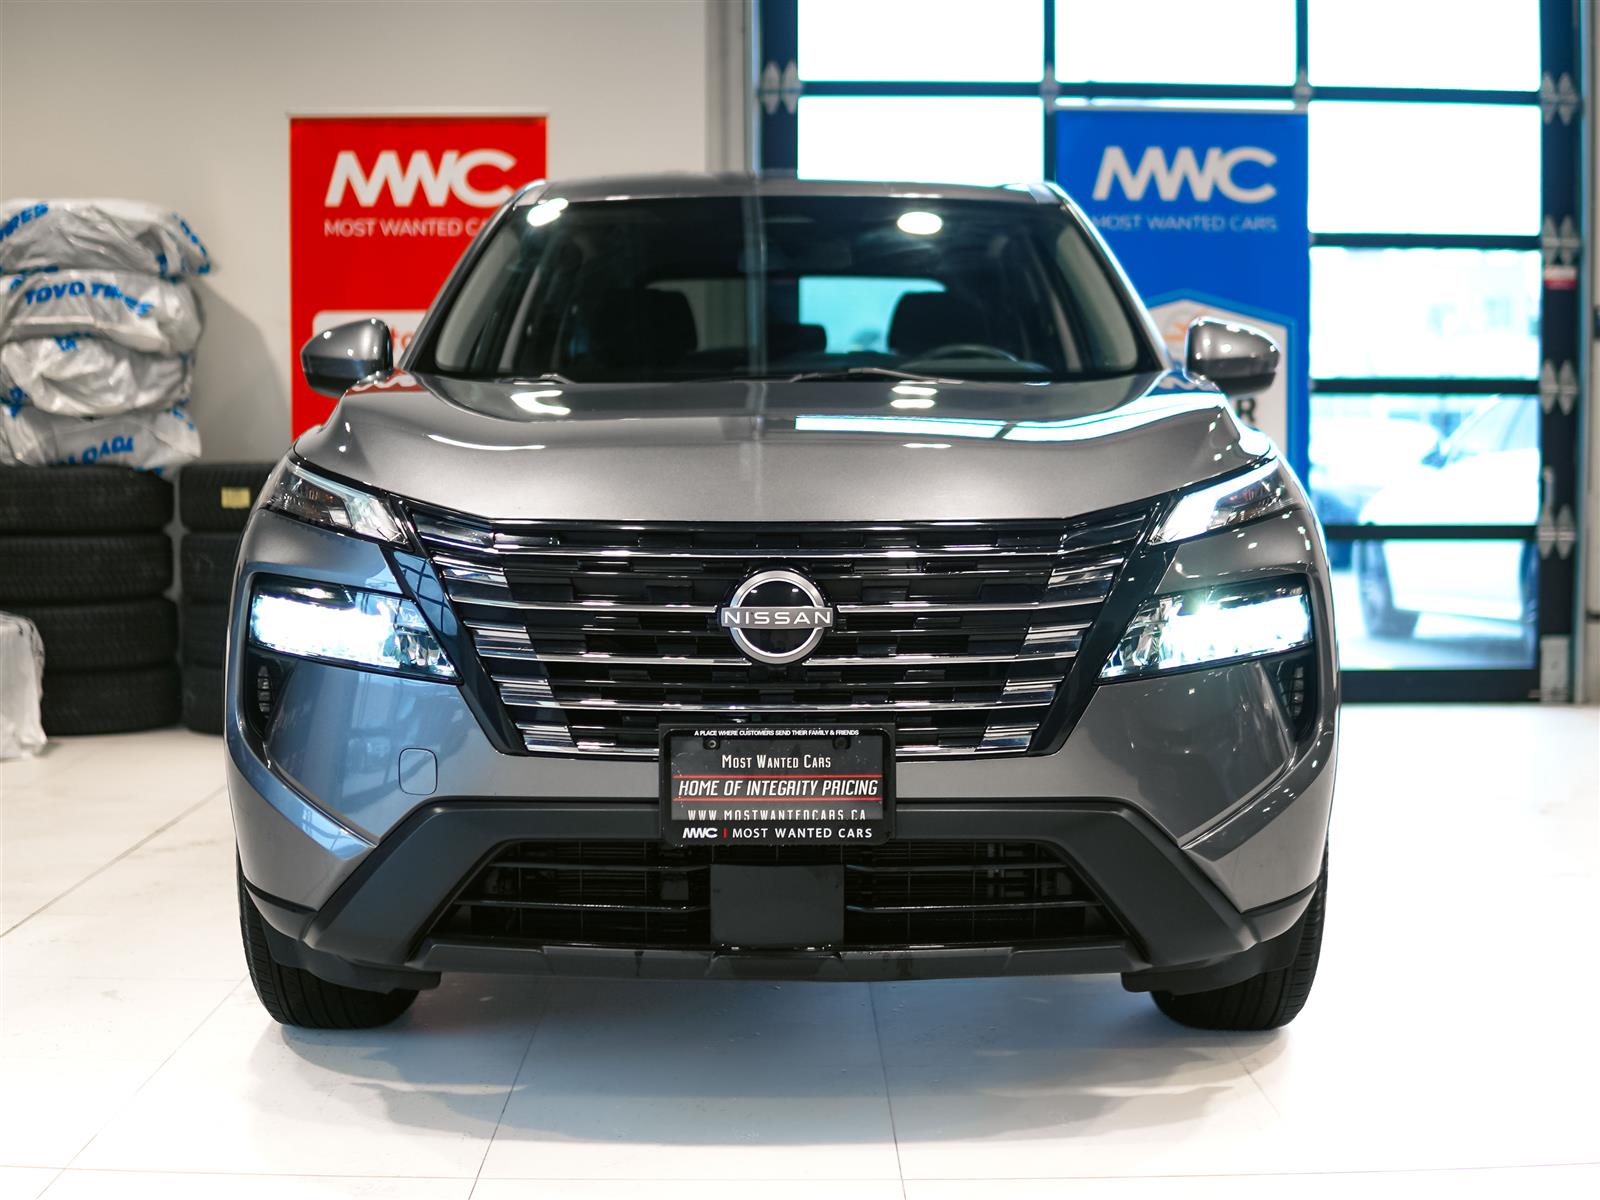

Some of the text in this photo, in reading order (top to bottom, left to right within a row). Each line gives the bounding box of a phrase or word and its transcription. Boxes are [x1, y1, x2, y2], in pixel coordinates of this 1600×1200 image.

[324, 148, 517, 208] MWC
[1092, 146, 1277, 203] MWC
[324, 218, 376, 237] MOST
[379, 218, 462, 237] WANTED
[1092, 215, 1277, 232] MOST WANTED CARS
[724, 611, 831, 625] NISSAN
[679, 780, 878, 796] HOME OF INTEGRITY PRICING
[682, 827, 872, 839] MWC MOST WANTED CARS
